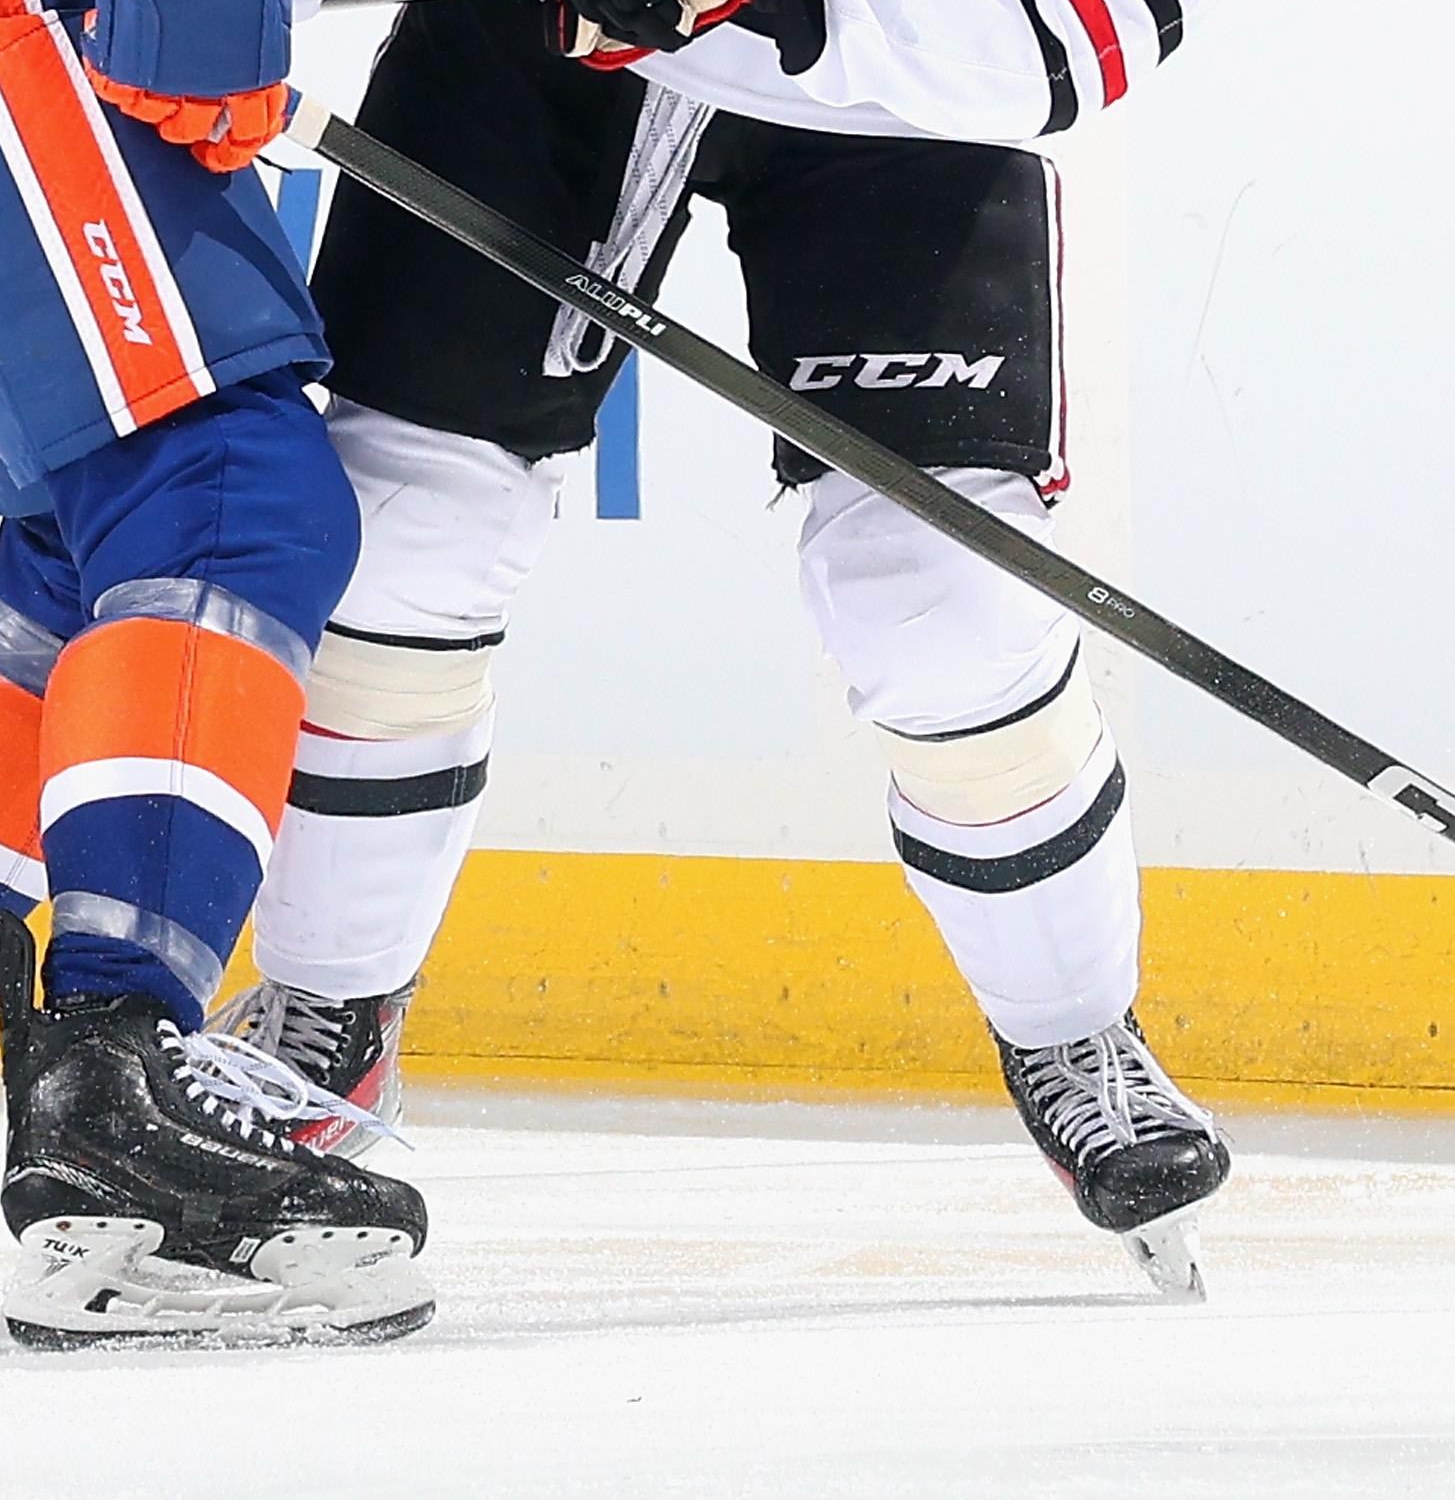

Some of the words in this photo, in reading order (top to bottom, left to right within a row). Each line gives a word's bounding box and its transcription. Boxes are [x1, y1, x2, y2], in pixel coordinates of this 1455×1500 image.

[81, 218, 153, 347] CCM
[565, 272, 667, 338] ALUPLI
[789, 352, 1006, 392] CCM
[1087, 586, 1110, 604] 8
